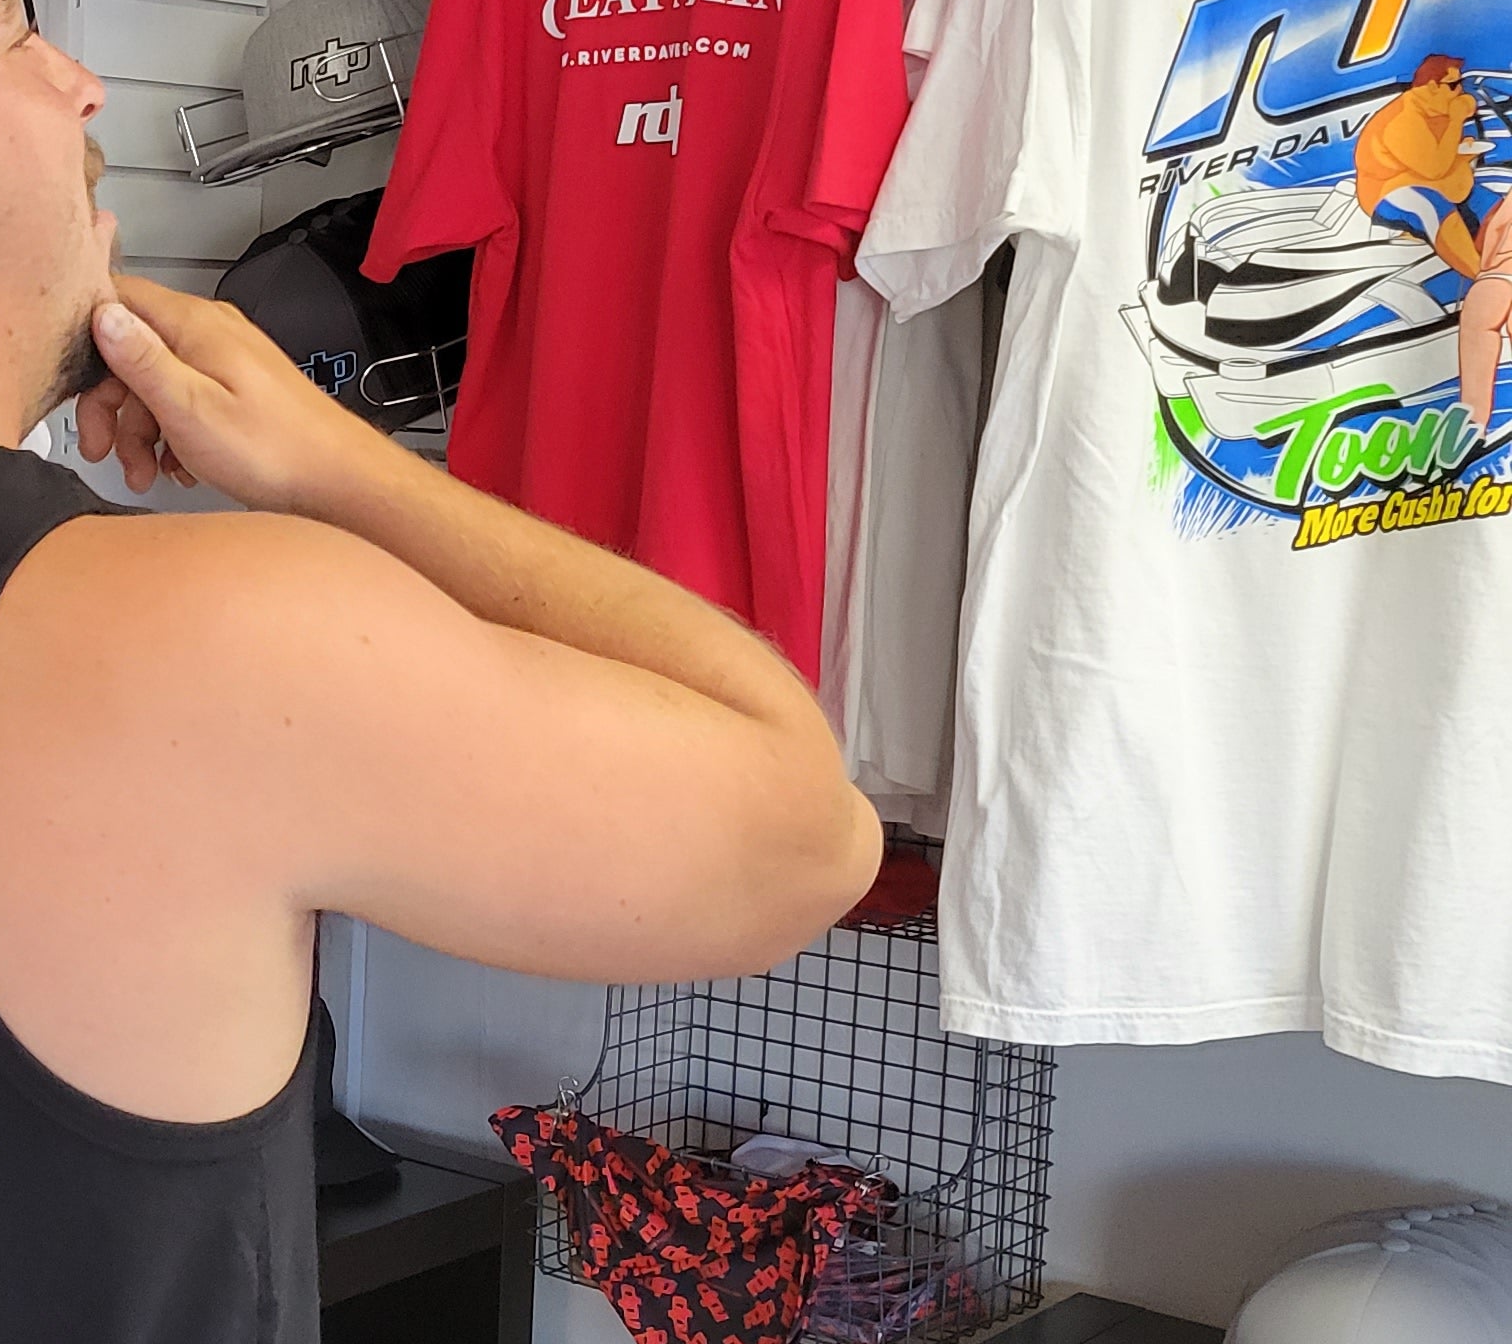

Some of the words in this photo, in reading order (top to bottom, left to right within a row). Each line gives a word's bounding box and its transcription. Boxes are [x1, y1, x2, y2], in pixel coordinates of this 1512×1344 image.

[616, 84, 683, 157] rd
[1139, 146, 1259, 199] RIVER
[1269, 112, 1370, 161] DAV
[297, 350, 358, 396] dp
[1252, 382, 1480, 503] Toon
[1293, 501, 1381, 548] More
